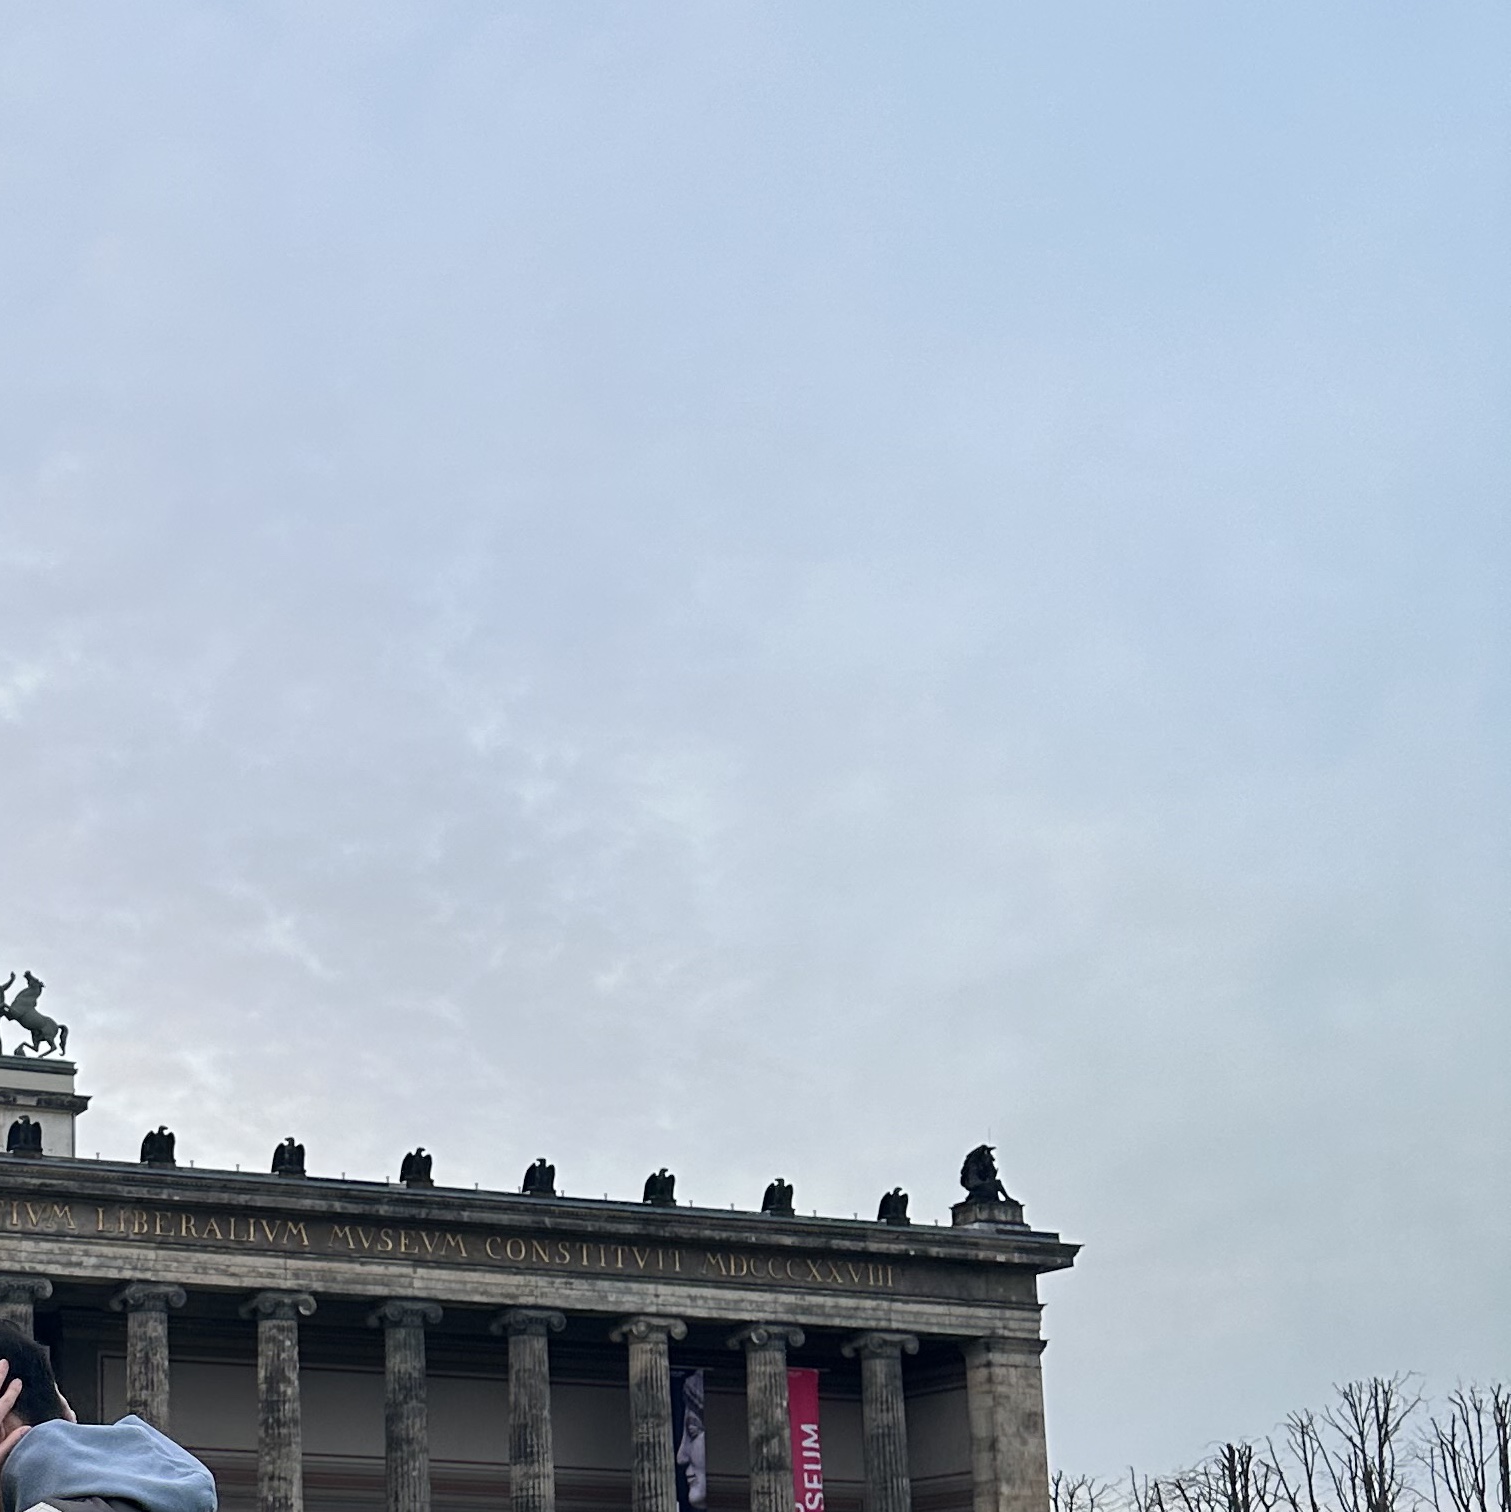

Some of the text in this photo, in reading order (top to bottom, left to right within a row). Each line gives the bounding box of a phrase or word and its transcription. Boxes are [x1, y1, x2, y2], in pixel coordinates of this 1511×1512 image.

[96, 1208, 310, 1246] LIBERALIVM
[328, 1225, 468, 1257] MVSEVM
[485, 1237, 686, 1272] CONSTITVIT
[701, 1252, 893, 1287] MDCCCXXVIII
